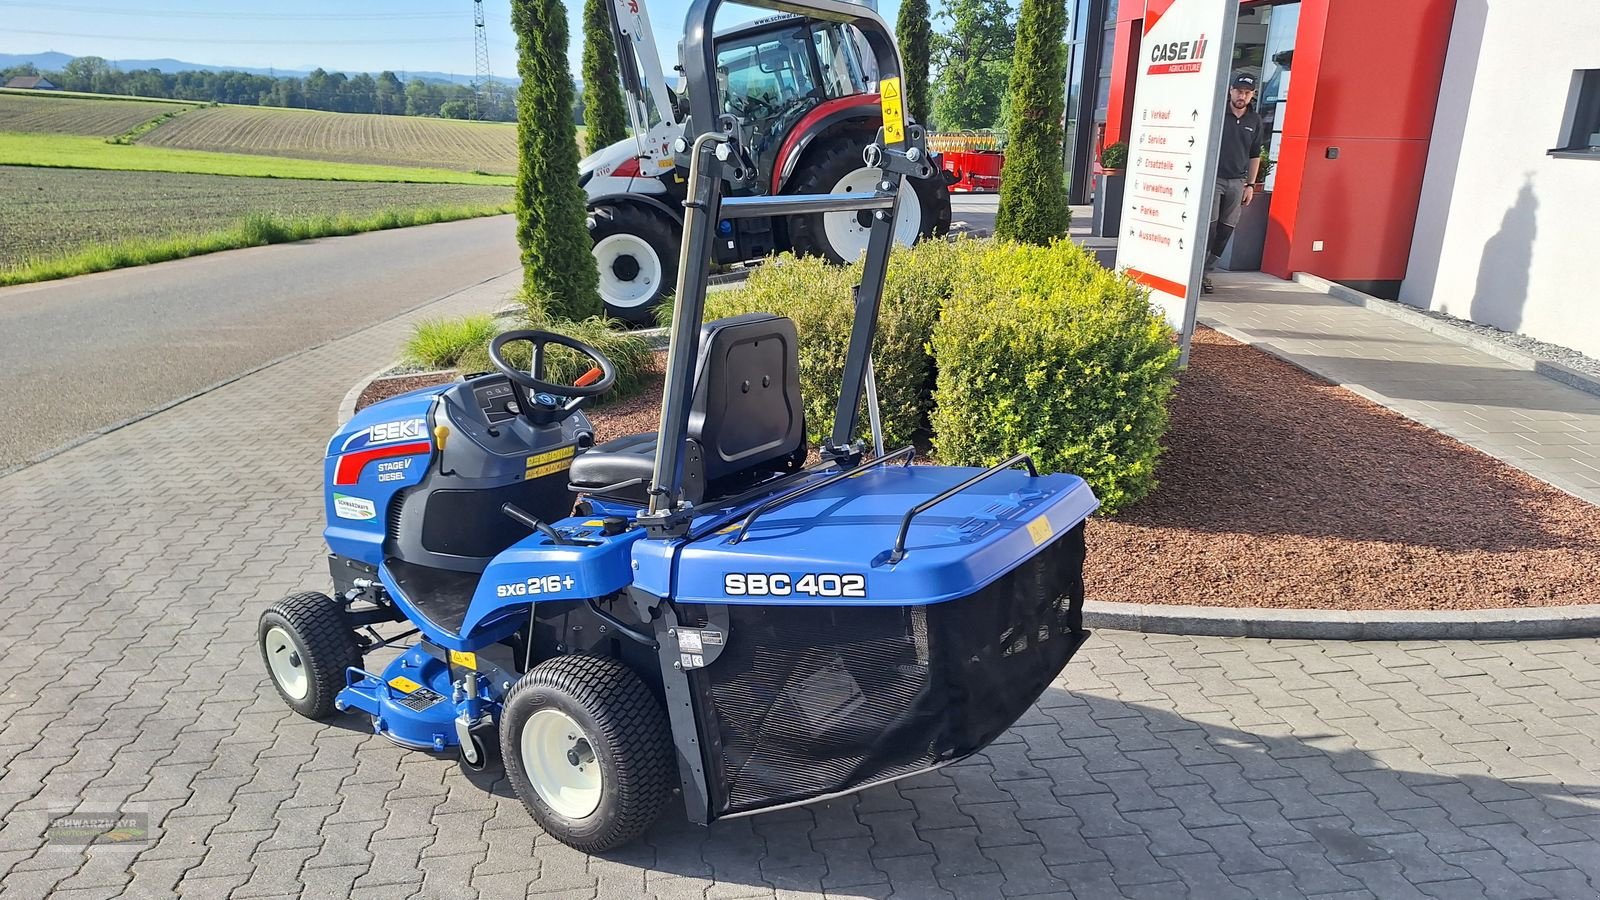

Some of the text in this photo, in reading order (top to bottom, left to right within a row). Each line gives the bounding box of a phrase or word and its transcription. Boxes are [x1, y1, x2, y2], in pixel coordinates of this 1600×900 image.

[1151, 41, 1190, 63] CASE
[1150, 109, 1171, 120] Verkauf
[1147, 134, 1167, 145] Service
[1145, 158, 1174, 171] Ersatzteile
[1142, 181, 1173, 197] Verwaltung
[1140, 205, 1159, 217] Parken
[1138, 230, 1171, 247] Ausstellung
[369, 418, 420, 442] ISEKI
[378, 458, 412, 472] STAGE V
[378, 471, 406, 482] DIESEL
[497, 575, 575, 597] SXG 216+
[725, 573, 866, 598] SBC 402
